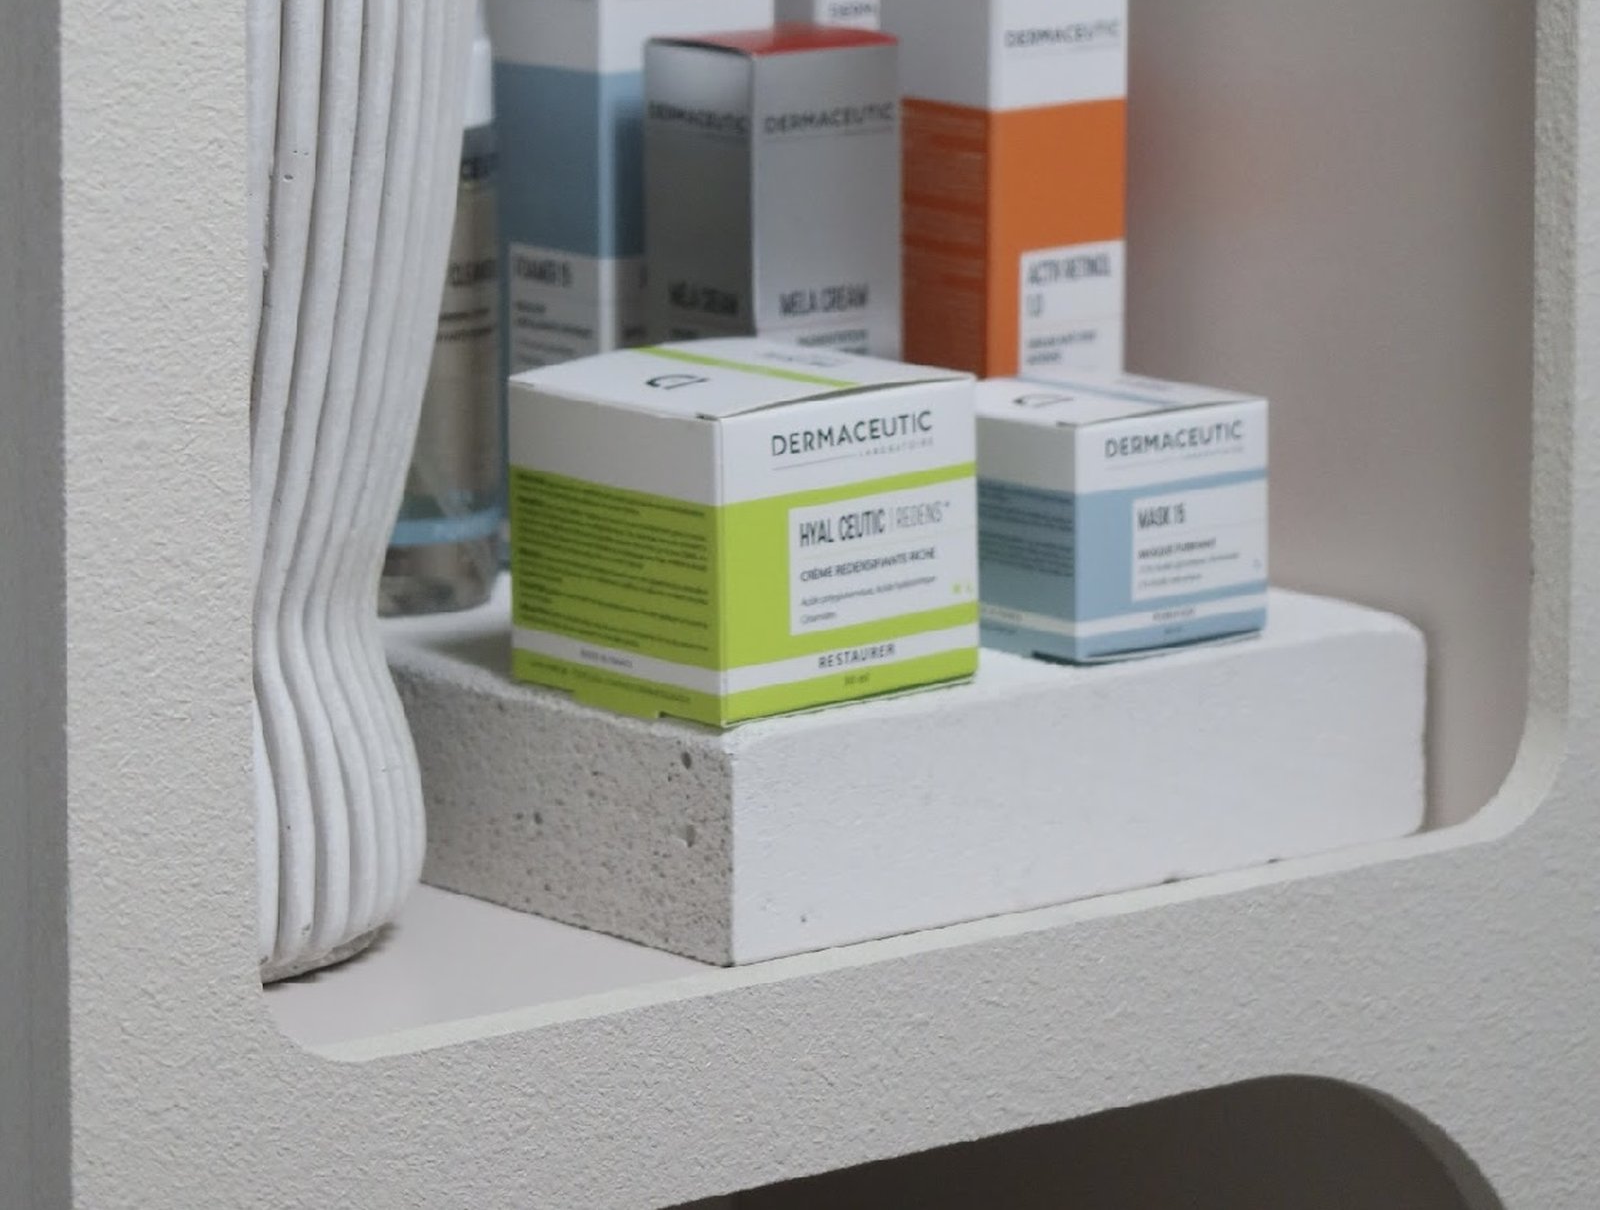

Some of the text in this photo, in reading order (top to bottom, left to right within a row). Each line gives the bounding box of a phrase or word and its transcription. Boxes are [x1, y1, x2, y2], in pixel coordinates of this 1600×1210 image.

[1003, 18, 1120, 49] DERMACEUTIC
[764, 101, 894, 135] DERMACEUTIC
[779, 287, 817, 318] MELA
[770, 410, 934, 457] DERMACEUTIC
[1104, 420, 1243, 459] DERMACEUTIC
[799, 518, 835, 548] HYAL
[837, 508, 885, 541] CEUTIC
[1137, 505, 1170, 529] MASK
[818, 643, 896, 669] RESTAURER
